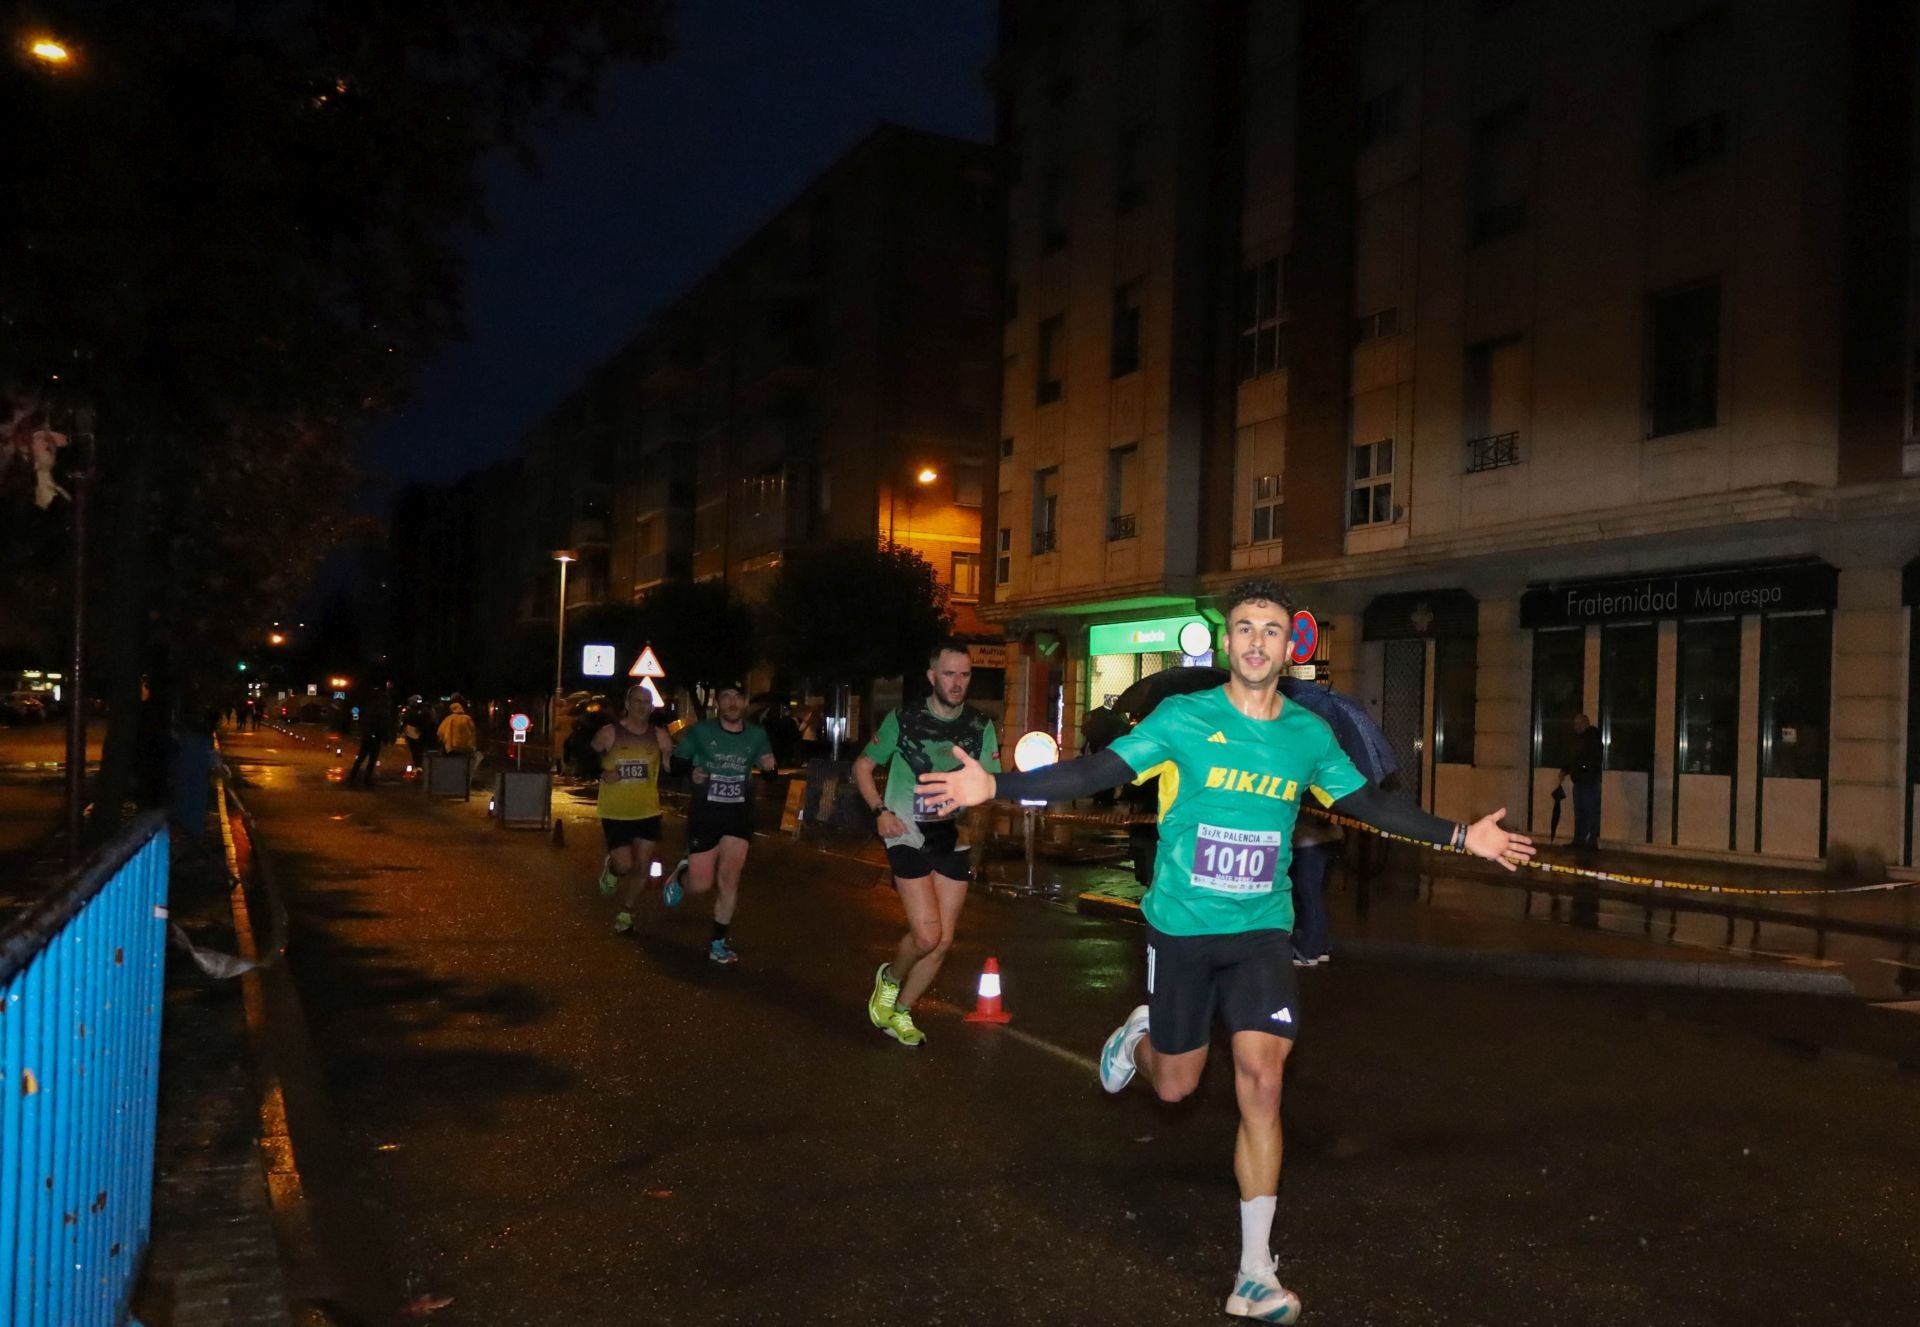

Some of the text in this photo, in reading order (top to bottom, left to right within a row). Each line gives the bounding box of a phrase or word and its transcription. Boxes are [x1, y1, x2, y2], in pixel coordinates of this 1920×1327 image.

[1567, 581, 1783, 616] Fraternidad Muprespa
[619, 765, 643, 777] 1162
[711, 783, 741, 796] 1235
[1205, 767, 1298, 801] BIKILA
[1224, 831, 1261, 843] PALENCIA
[1204, 844, 1265, 877] 1010
